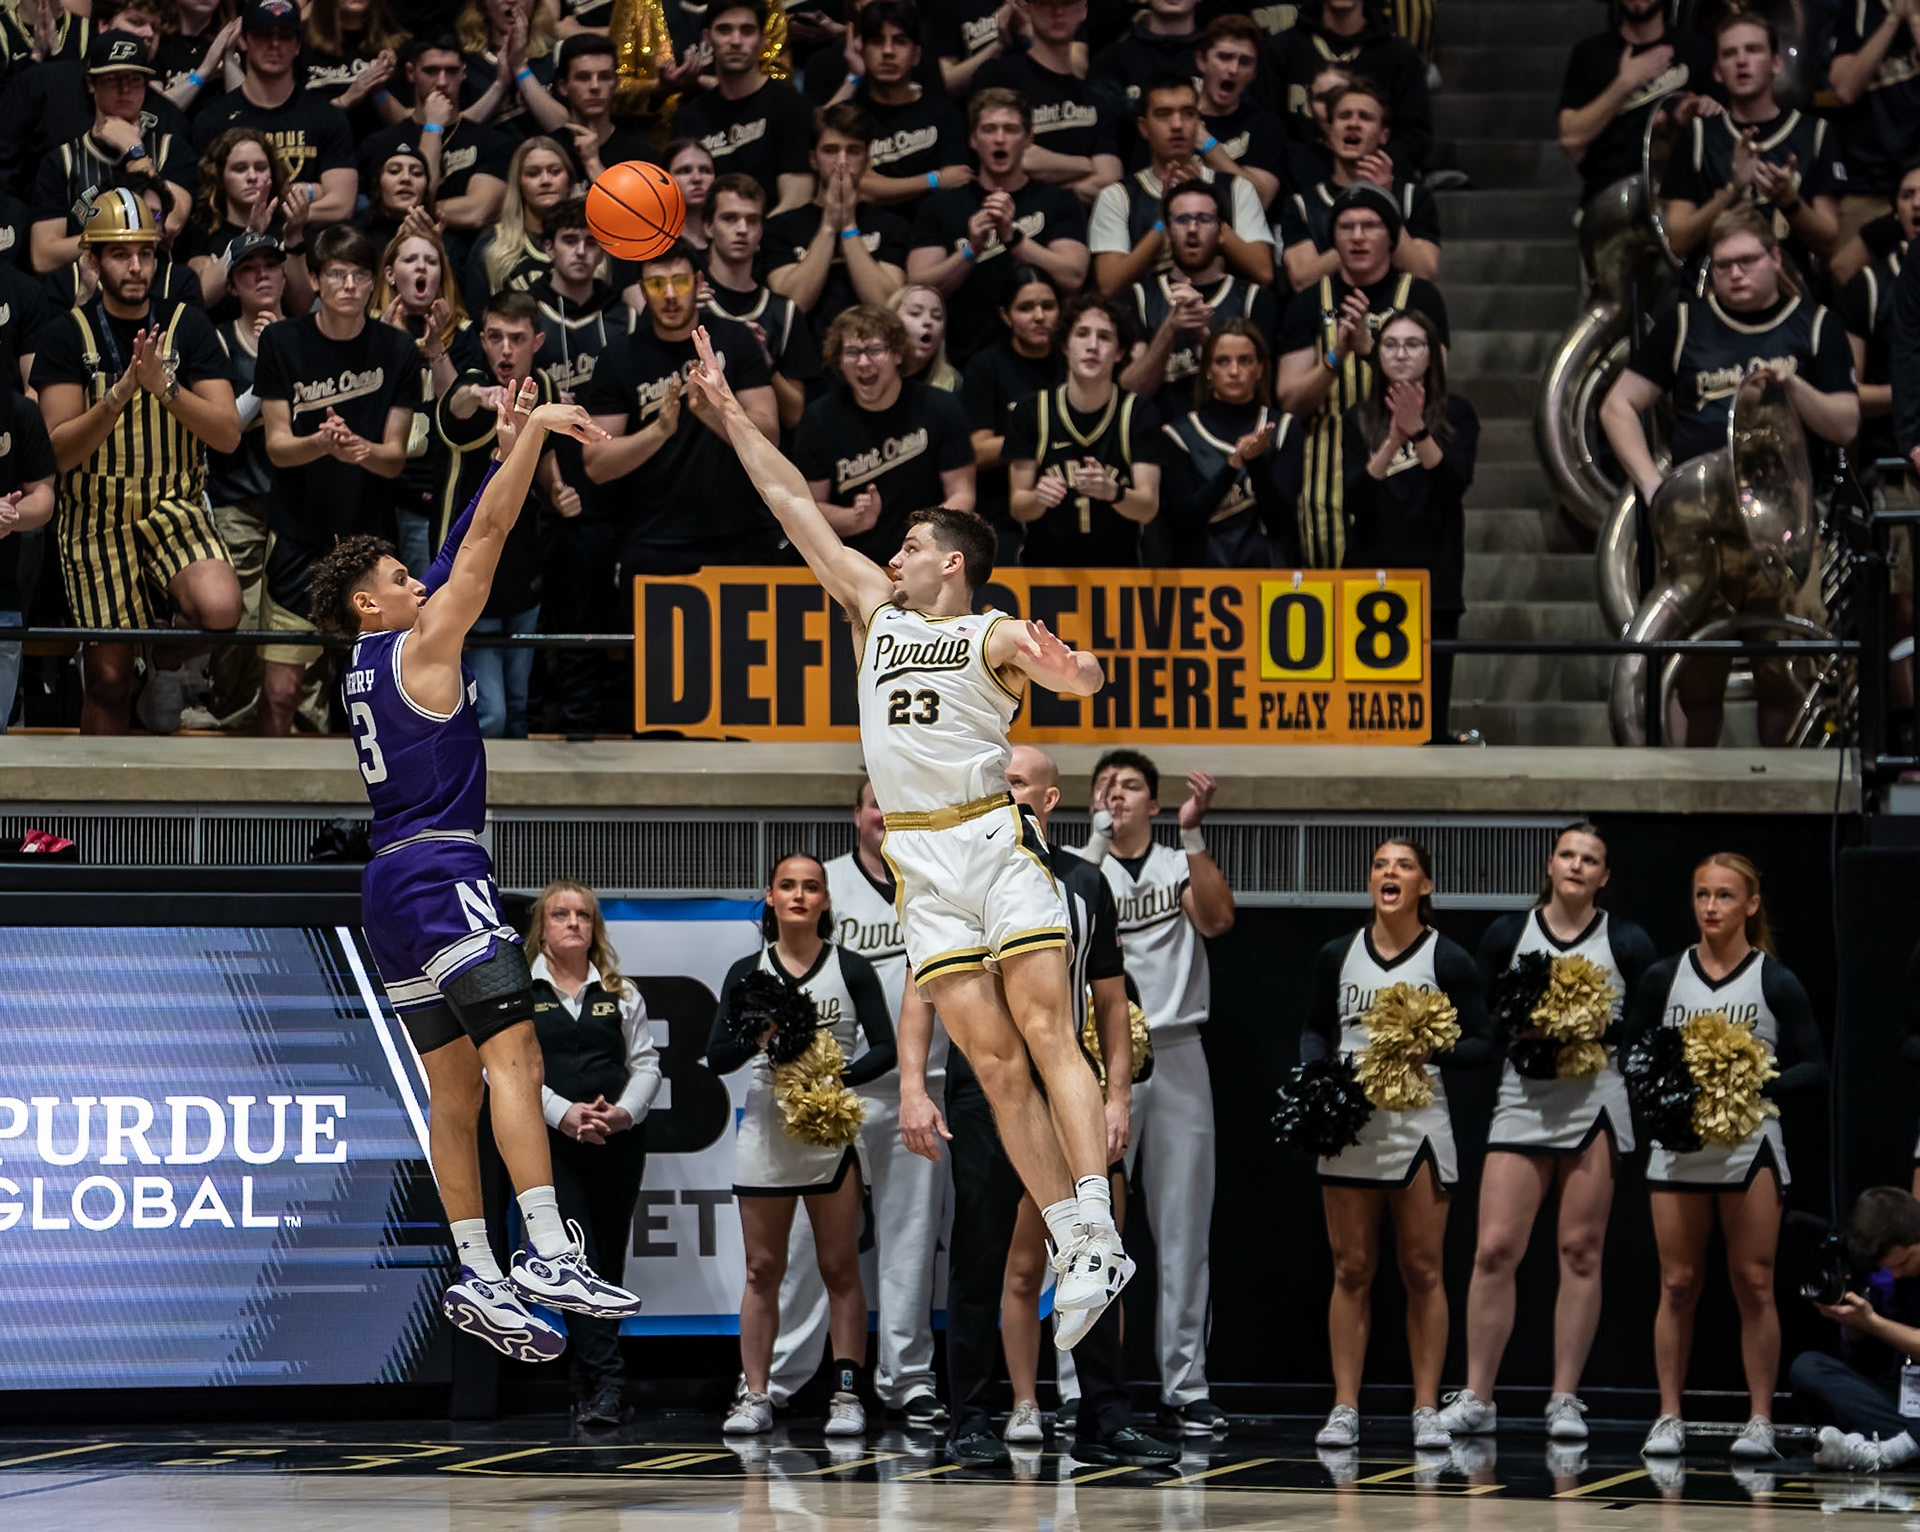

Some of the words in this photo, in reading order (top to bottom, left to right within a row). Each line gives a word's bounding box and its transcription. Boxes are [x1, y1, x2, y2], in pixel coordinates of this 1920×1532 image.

[338, 366, 385, 393] Crew
[836, 447, 883, 483] Paint
[881, 427, 929, 462] Crew
[1090, 585, 1244, 652] LIVES
[645, 583, 1081, 727] DEFE
[873, 633, 970, 681] Purdue
[887, 688, 941, 727] 23
[1092, 656, 1248, 729] HERE
[1258, 692, 1331, 730] PLAY
[1347, 692, 1425, 730] HARD
[351, 701, 388, 785] 3
[455, 878, 503, 932] N
